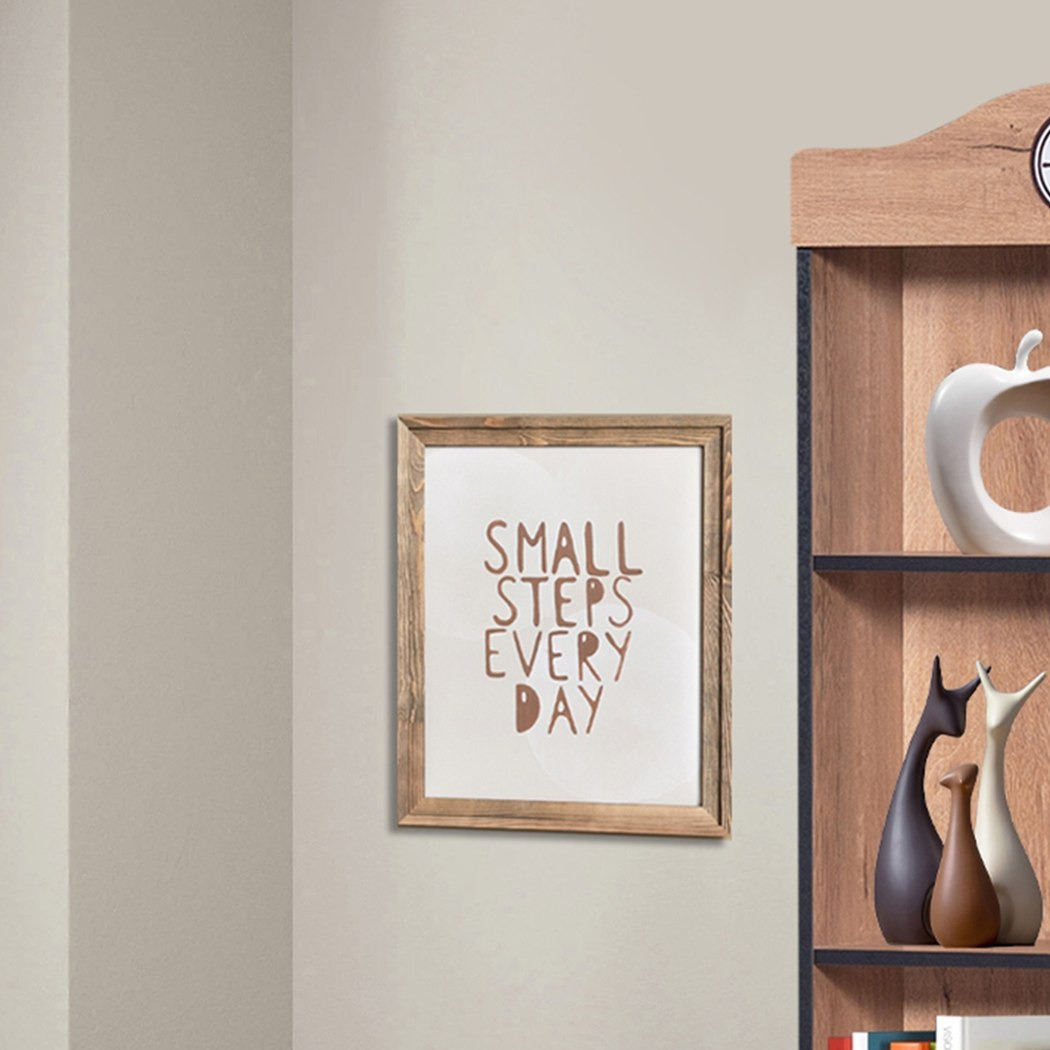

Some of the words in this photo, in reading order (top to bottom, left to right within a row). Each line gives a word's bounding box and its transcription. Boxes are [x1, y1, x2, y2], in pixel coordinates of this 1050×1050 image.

[484, 520, 643, 576] SMALL
[492, 576, 634, 628] STEPS
[485, 629, 632, 682] EVERY
[516, 683, 603, 735] DAY
